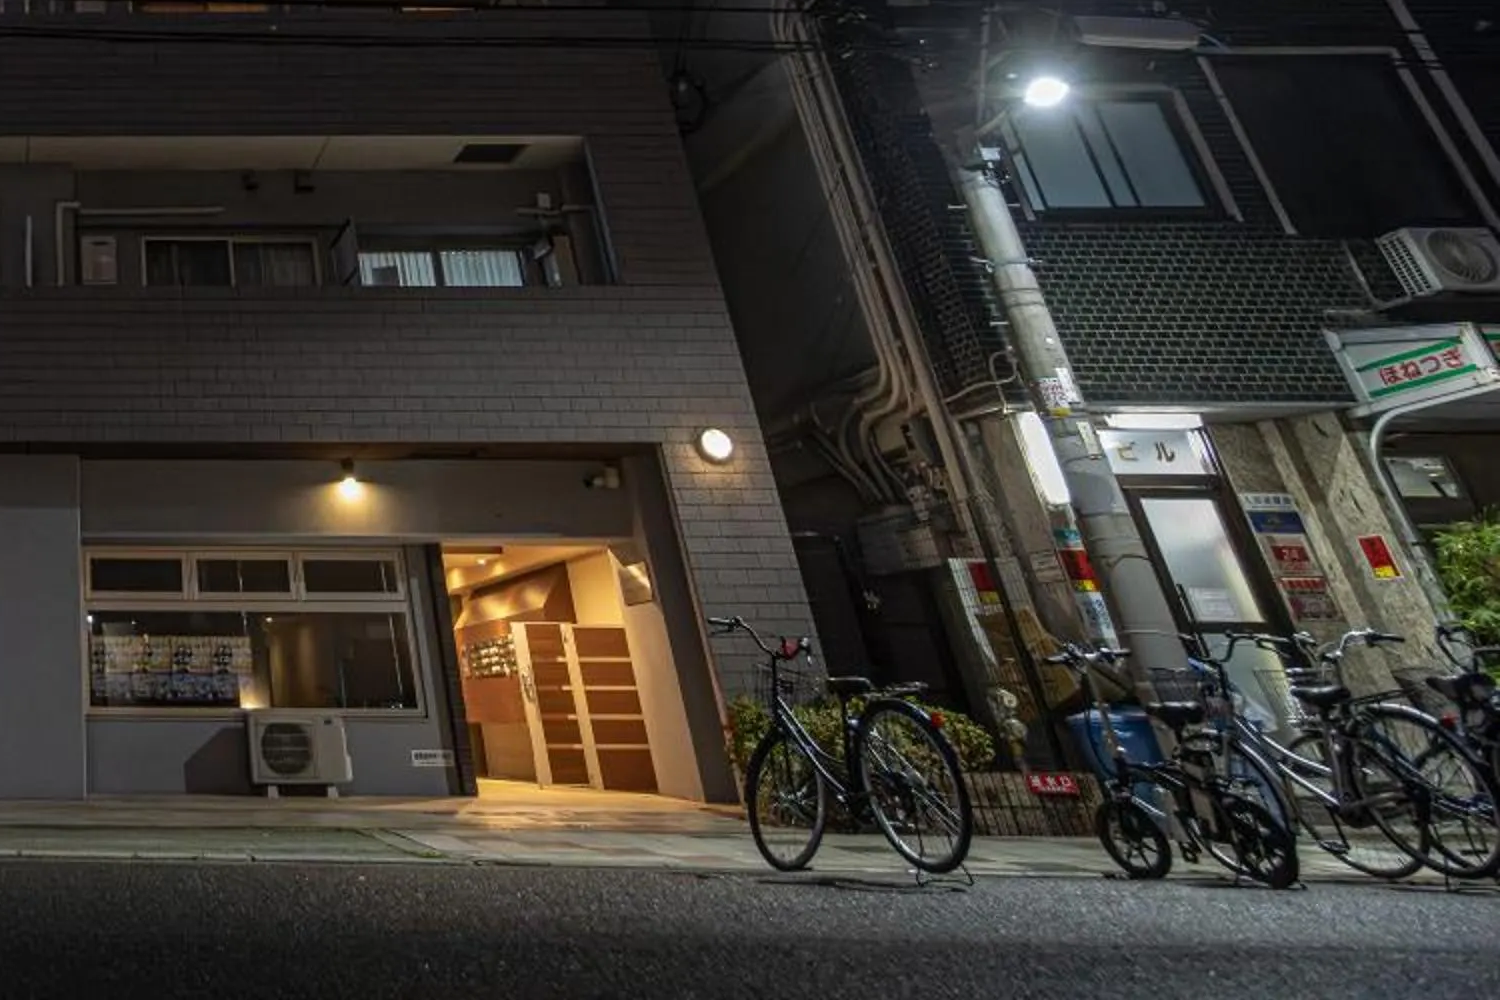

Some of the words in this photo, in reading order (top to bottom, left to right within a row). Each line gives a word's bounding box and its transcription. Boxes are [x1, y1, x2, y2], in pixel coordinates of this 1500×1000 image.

[1379, 347, 1464, 385] ほねつぎ
[1117, 441, 1176, 462] ビル
